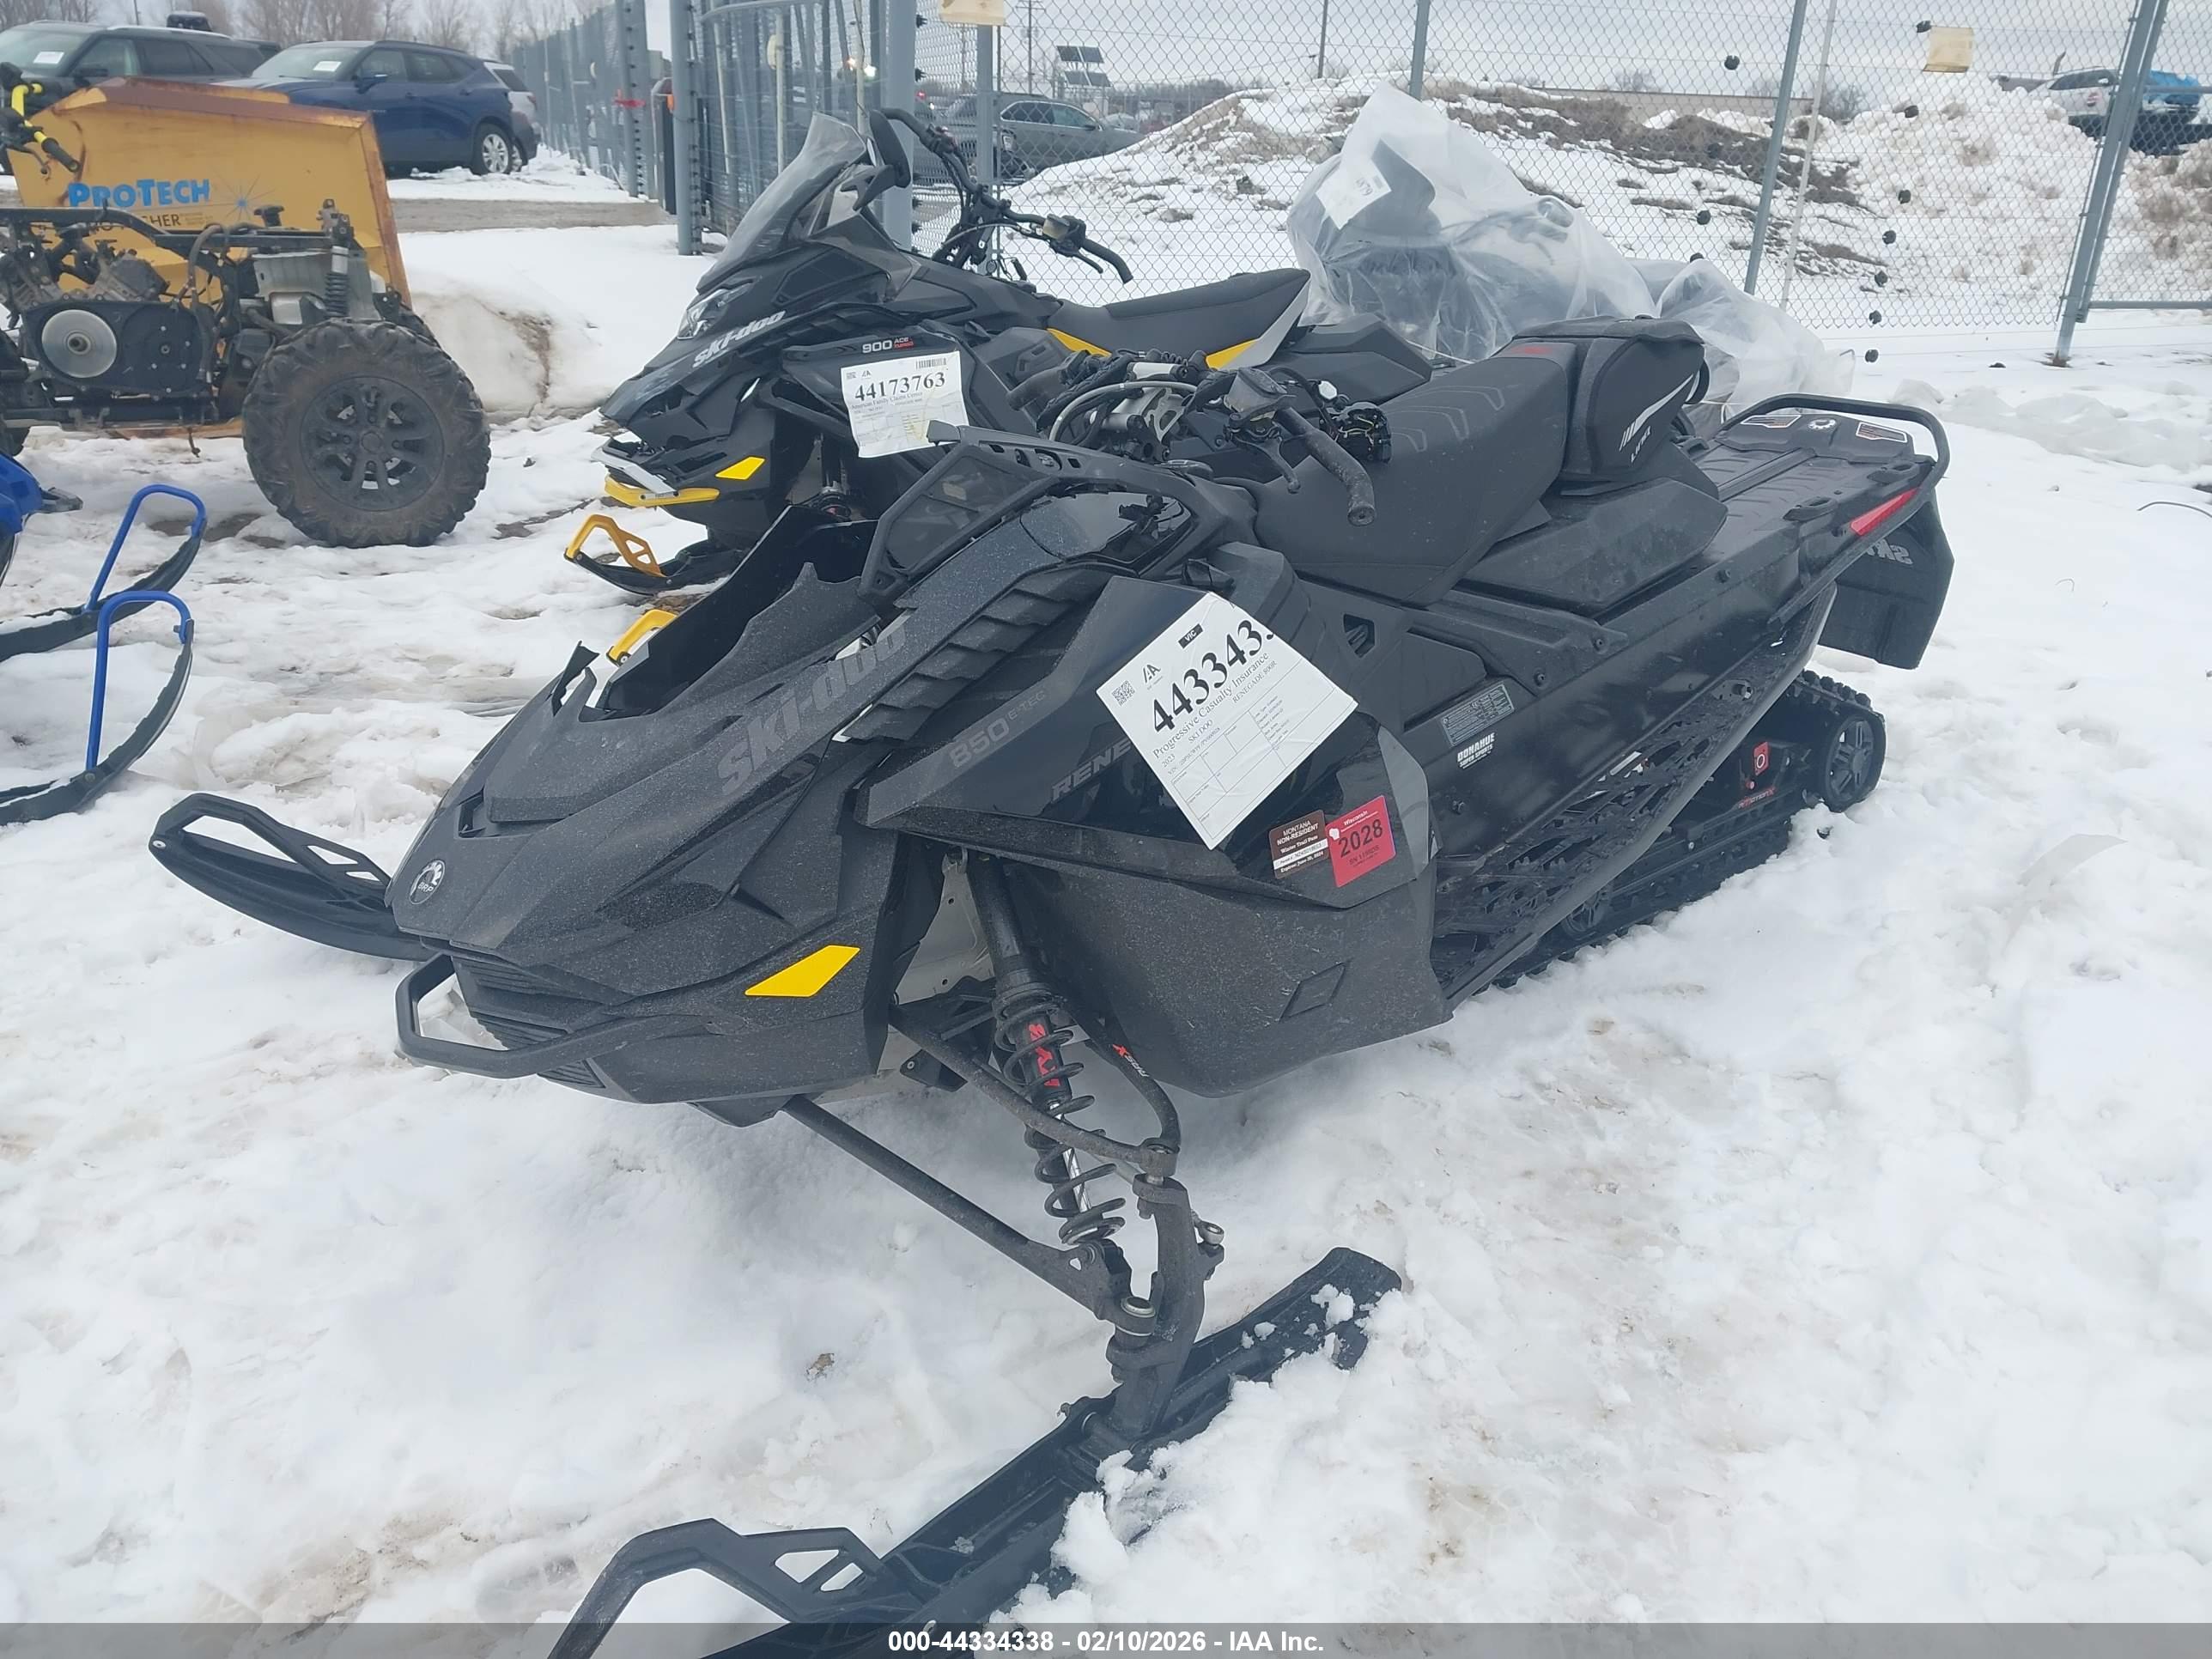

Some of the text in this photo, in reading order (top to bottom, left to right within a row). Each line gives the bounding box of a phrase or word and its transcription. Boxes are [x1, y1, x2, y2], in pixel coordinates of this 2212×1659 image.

[862, 339, 893, 354] 900
[854, 371, 946, 402] 44173763
[1184, 630, 1197, 642] VIC
[1153, 619, 1275, 732] 4433433
[1152, 716, 1200, 759] Progressive
[1198, 686, 1233, 719] Casualty
[1231, 652, 1269, 688] Insurance
[1162, 753, 1176, 769] 2023
[1188, 729, 1200, 744] SKI
[1199, 719, 1214, 736] DOO
[1231, 672, 1265, 704] RENEGADE
[948, 690, 1046, 768] 850 E-TEC
[1457, 732, 1495, 763] DONAHUE
[1459, 755, 1475, 768] SUPER
[1474, 743, 1493, 758] SPORTS
[1052, 735, 1132, 804] RENE
[1282, 819, 1312, 836] MONTANA
[1343, 810, 1369, 826] Wisconsin
[1277, 822, 1320, 846] NON-RESIDENT
[1338, 818, 1383, 858] 2028
[417, 881, 434, 893] BRP
